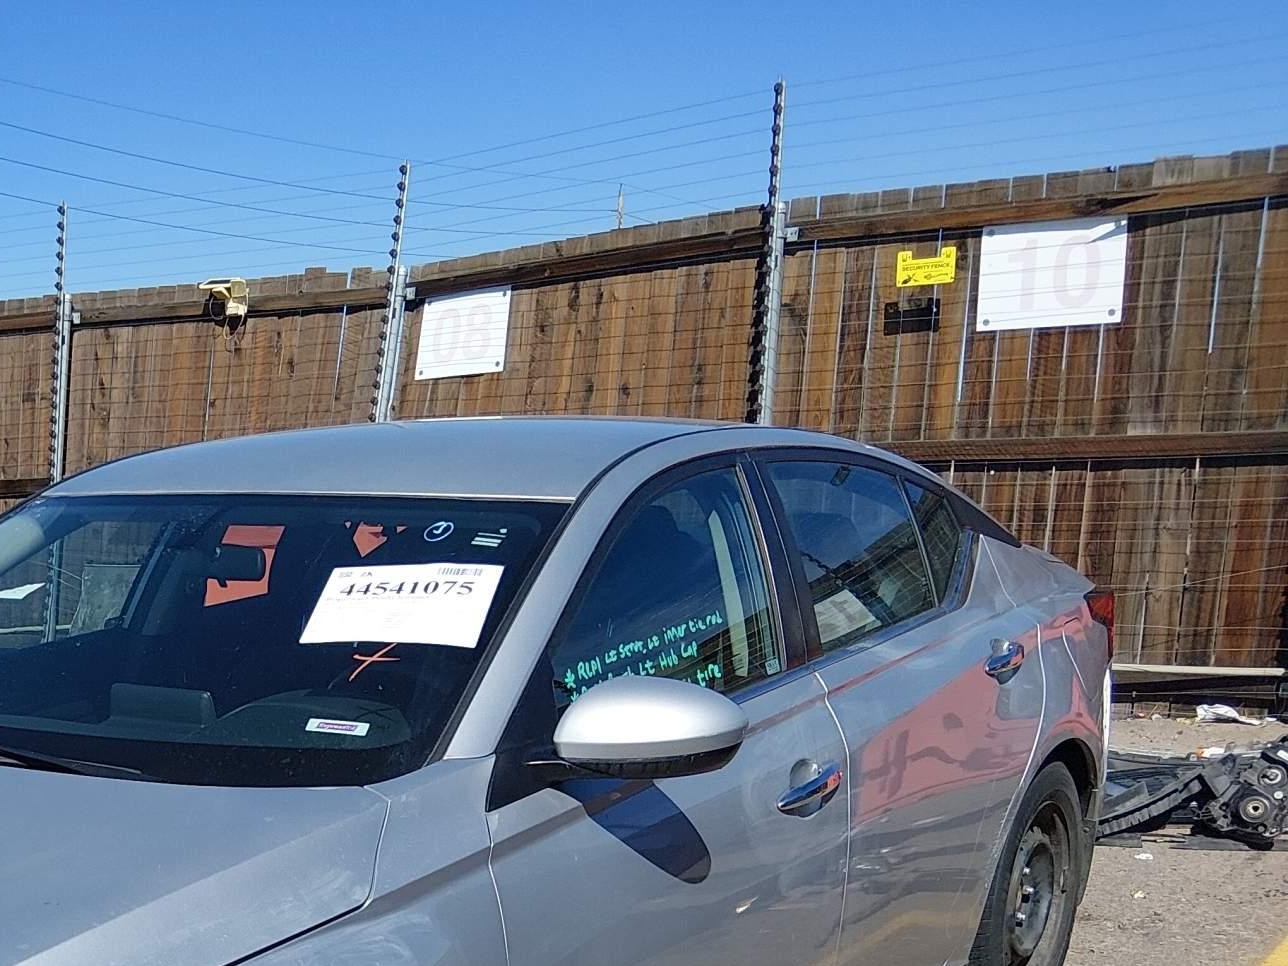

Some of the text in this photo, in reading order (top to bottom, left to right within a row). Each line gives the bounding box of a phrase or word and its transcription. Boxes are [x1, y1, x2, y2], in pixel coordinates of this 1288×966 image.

[1008, 234, 1101, 311] 10
[433, 303, 493, 361] 08
[340, 580, 475, 597] 44541075
